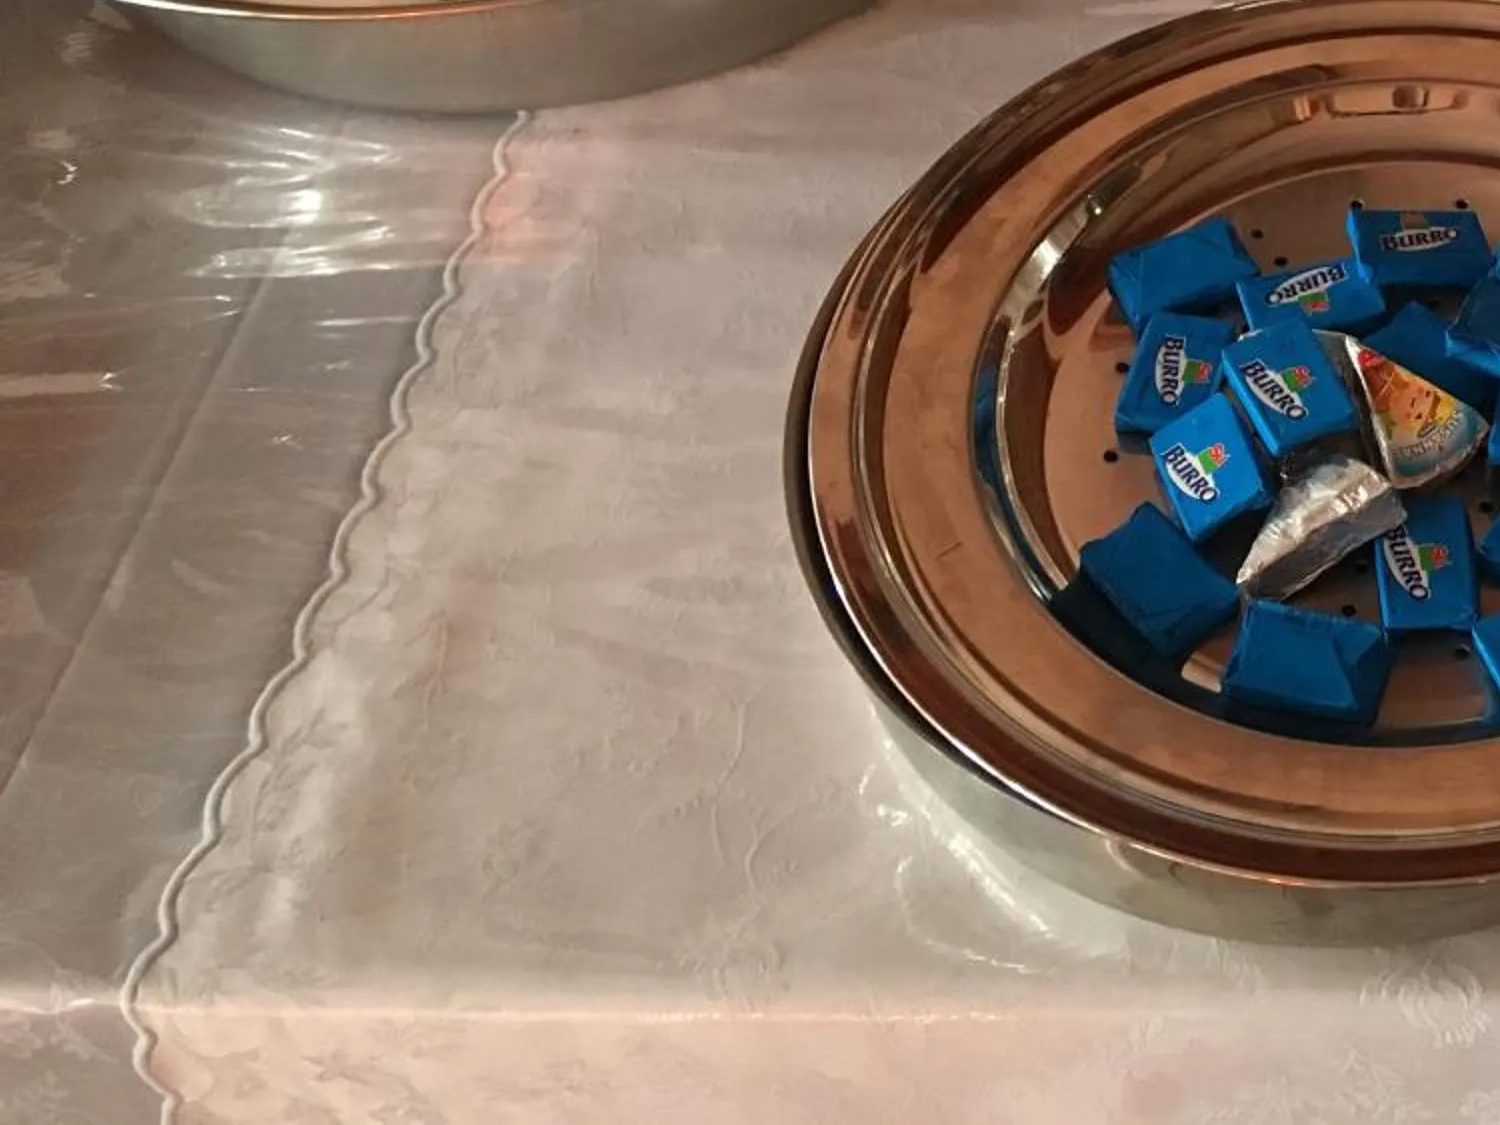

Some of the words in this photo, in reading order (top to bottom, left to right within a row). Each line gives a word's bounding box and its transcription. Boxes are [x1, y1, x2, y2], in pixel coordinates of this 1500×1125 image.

[1380, 227, 1459, 252] BURRO
[1266, 261, 1346, 305] BURRO
[1162, 335, 1186, 406] BURRO
[1240, 359, 1307, 420] BURRO
[1163, 443, 1218, 502] BURRO
[1386, 525, 1430, 601] BURRO
